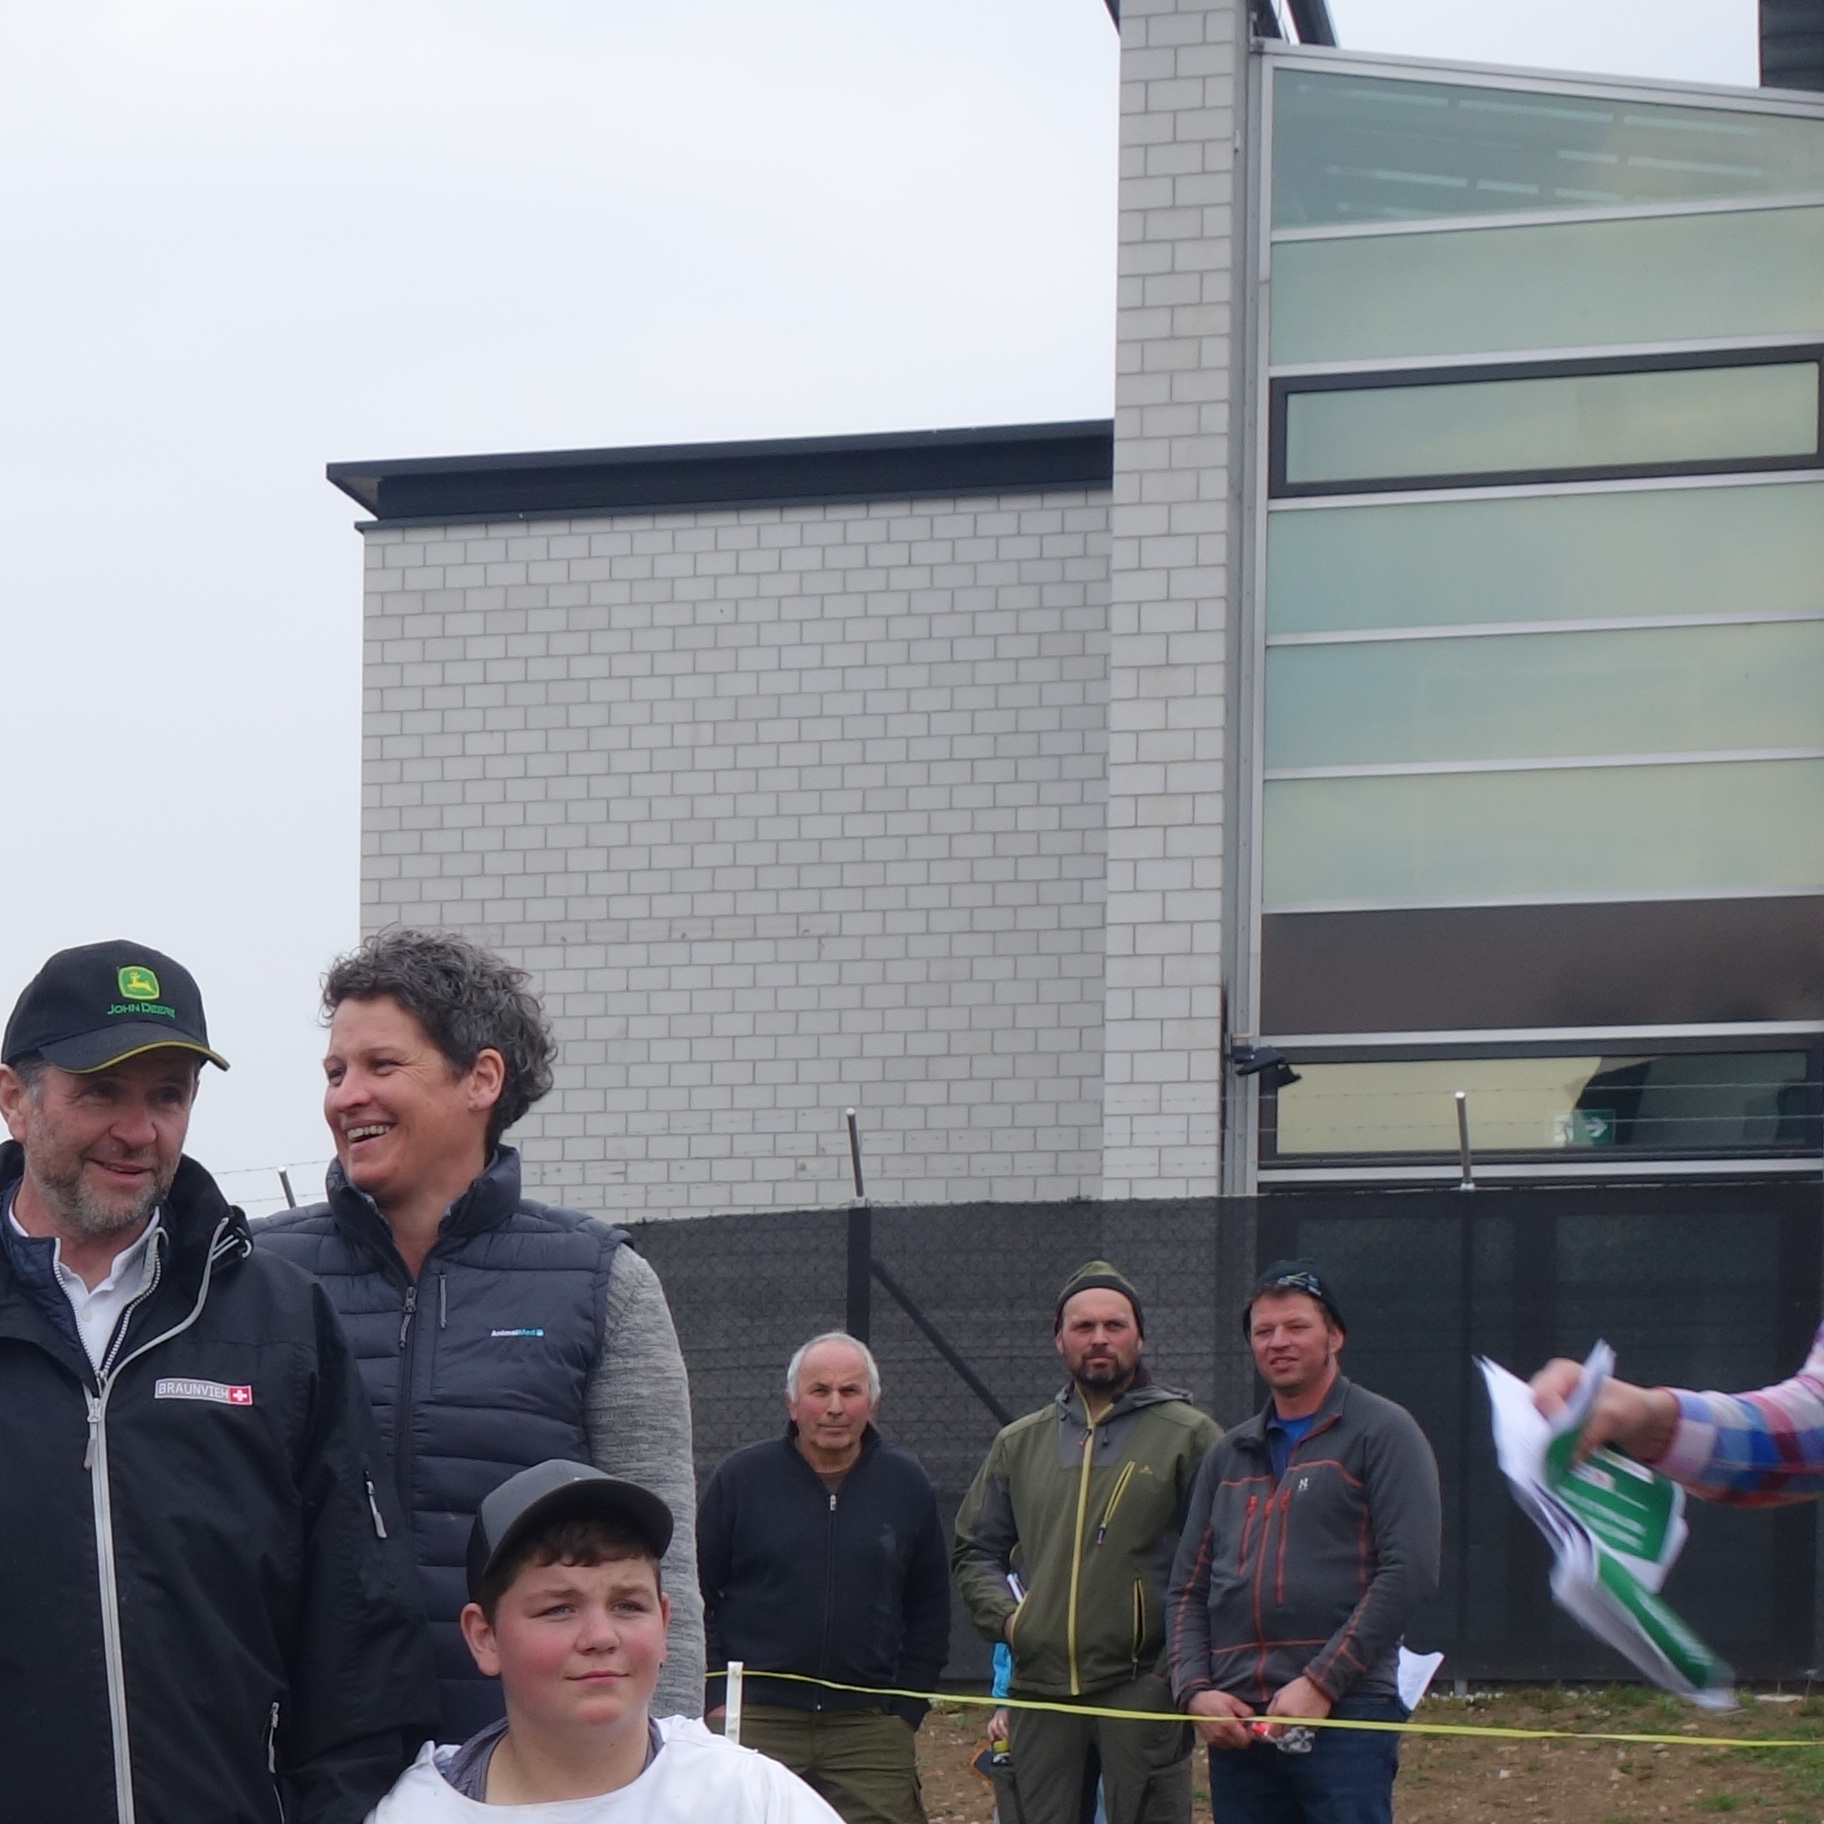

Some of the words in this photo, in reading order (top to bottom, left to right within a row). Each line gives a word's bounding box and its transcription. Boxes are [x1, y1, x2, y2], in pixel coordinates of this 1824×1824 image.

[107, 1004, 140, 1015] JOHN
[141, 1002, 175, 1018] DEERE
[158, 1382, 229, 1399] BRAUNVIEH
